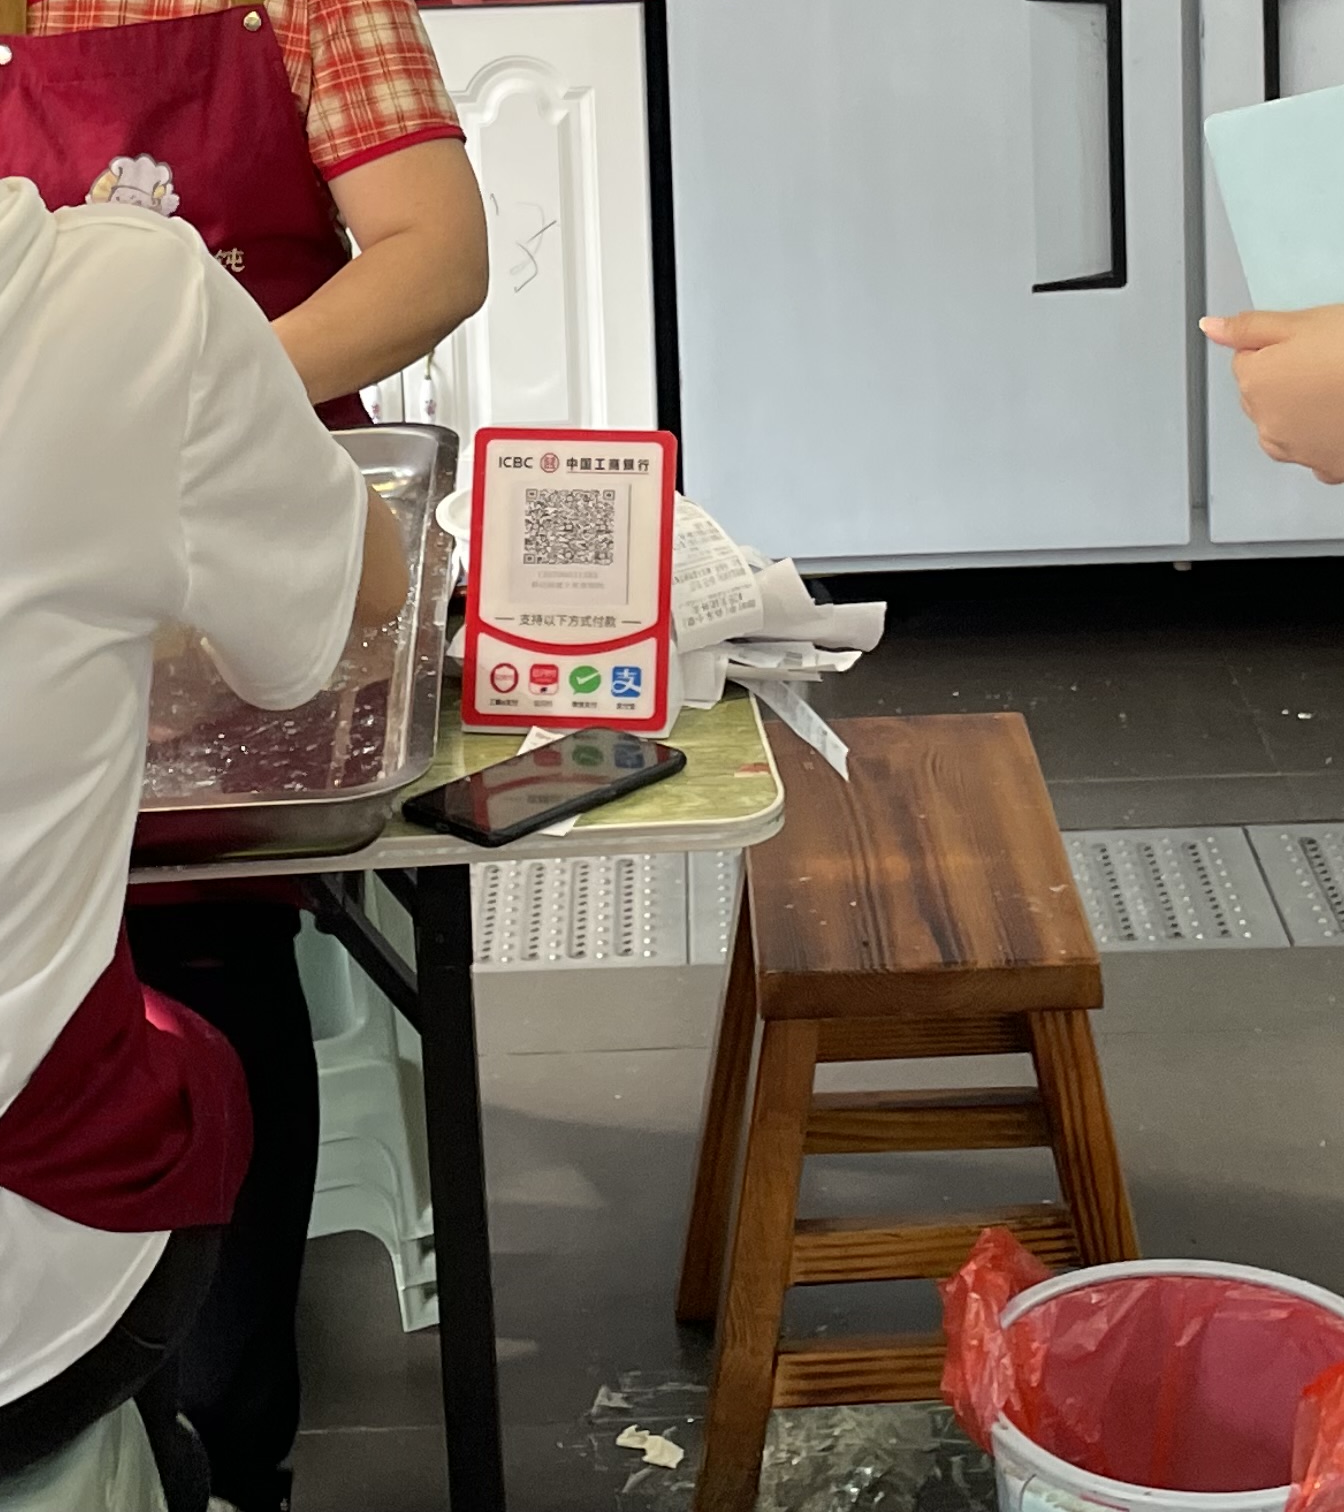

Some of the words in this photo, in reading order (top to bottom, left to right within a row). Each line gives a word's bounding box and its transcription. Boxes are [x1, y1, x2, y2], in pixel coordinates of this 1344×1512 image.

[498, 456, 534, 470] ICBC
[565, 456, 651, 473] 中国工商银行
[518, 613, 617, 629] 支持以下方式付款
